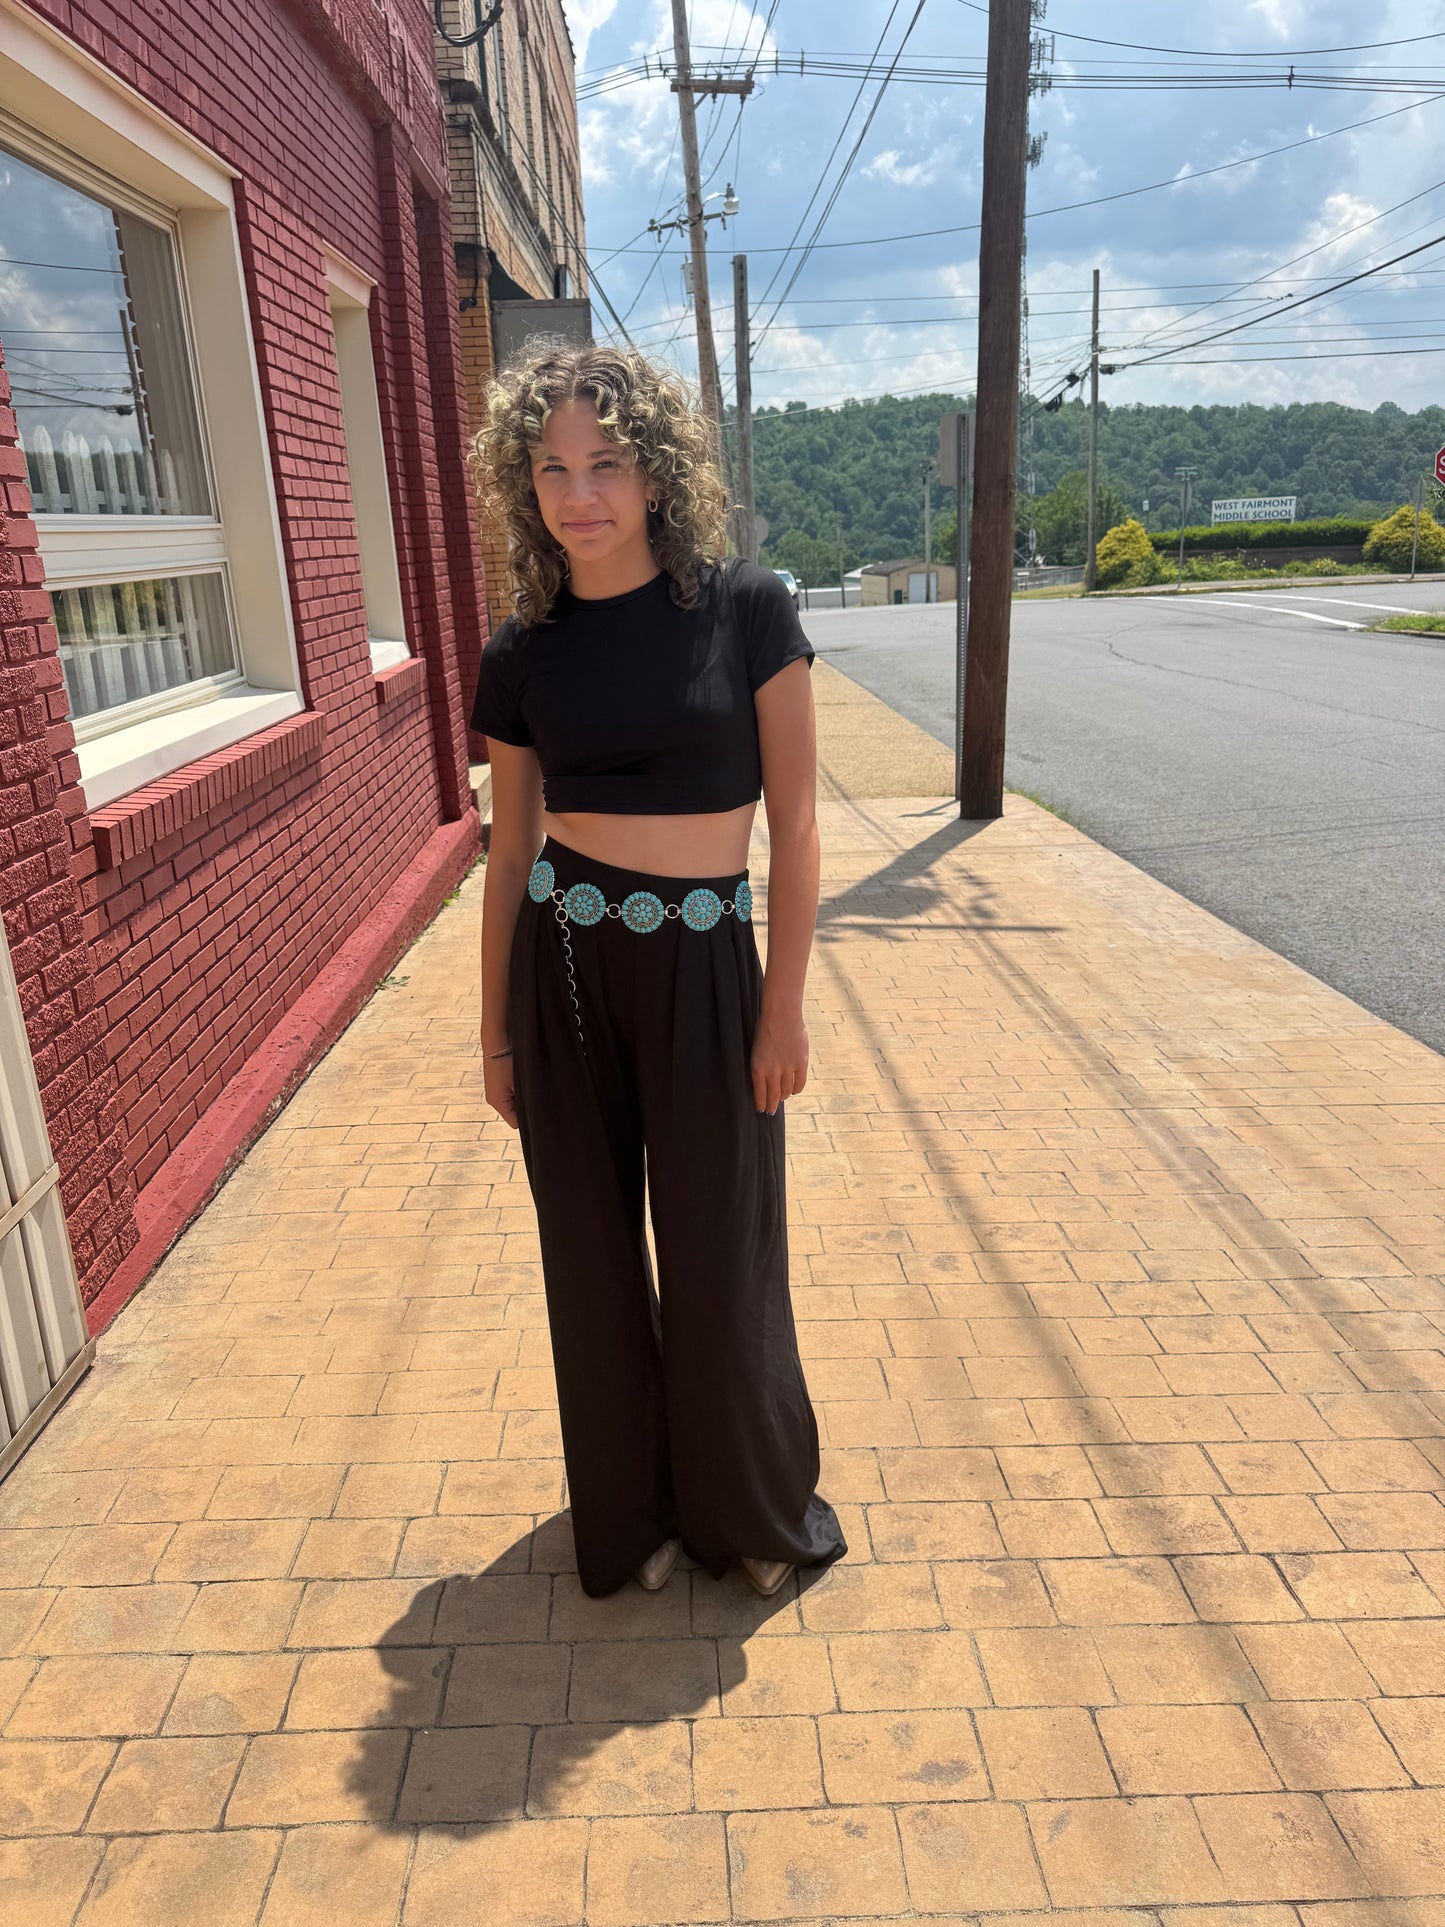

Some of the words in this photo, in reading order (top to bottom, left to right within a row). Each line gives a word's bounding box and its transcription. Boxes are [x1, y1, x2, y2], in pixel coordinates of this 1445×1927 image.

[1214, 502, 1239, 510] WEST
[1241, 499, 1293, 509] FAIRMONT
[1213, 512, 1249, 520] MIDDLE
[1252, 510, 1292, 519] SCHOOL
